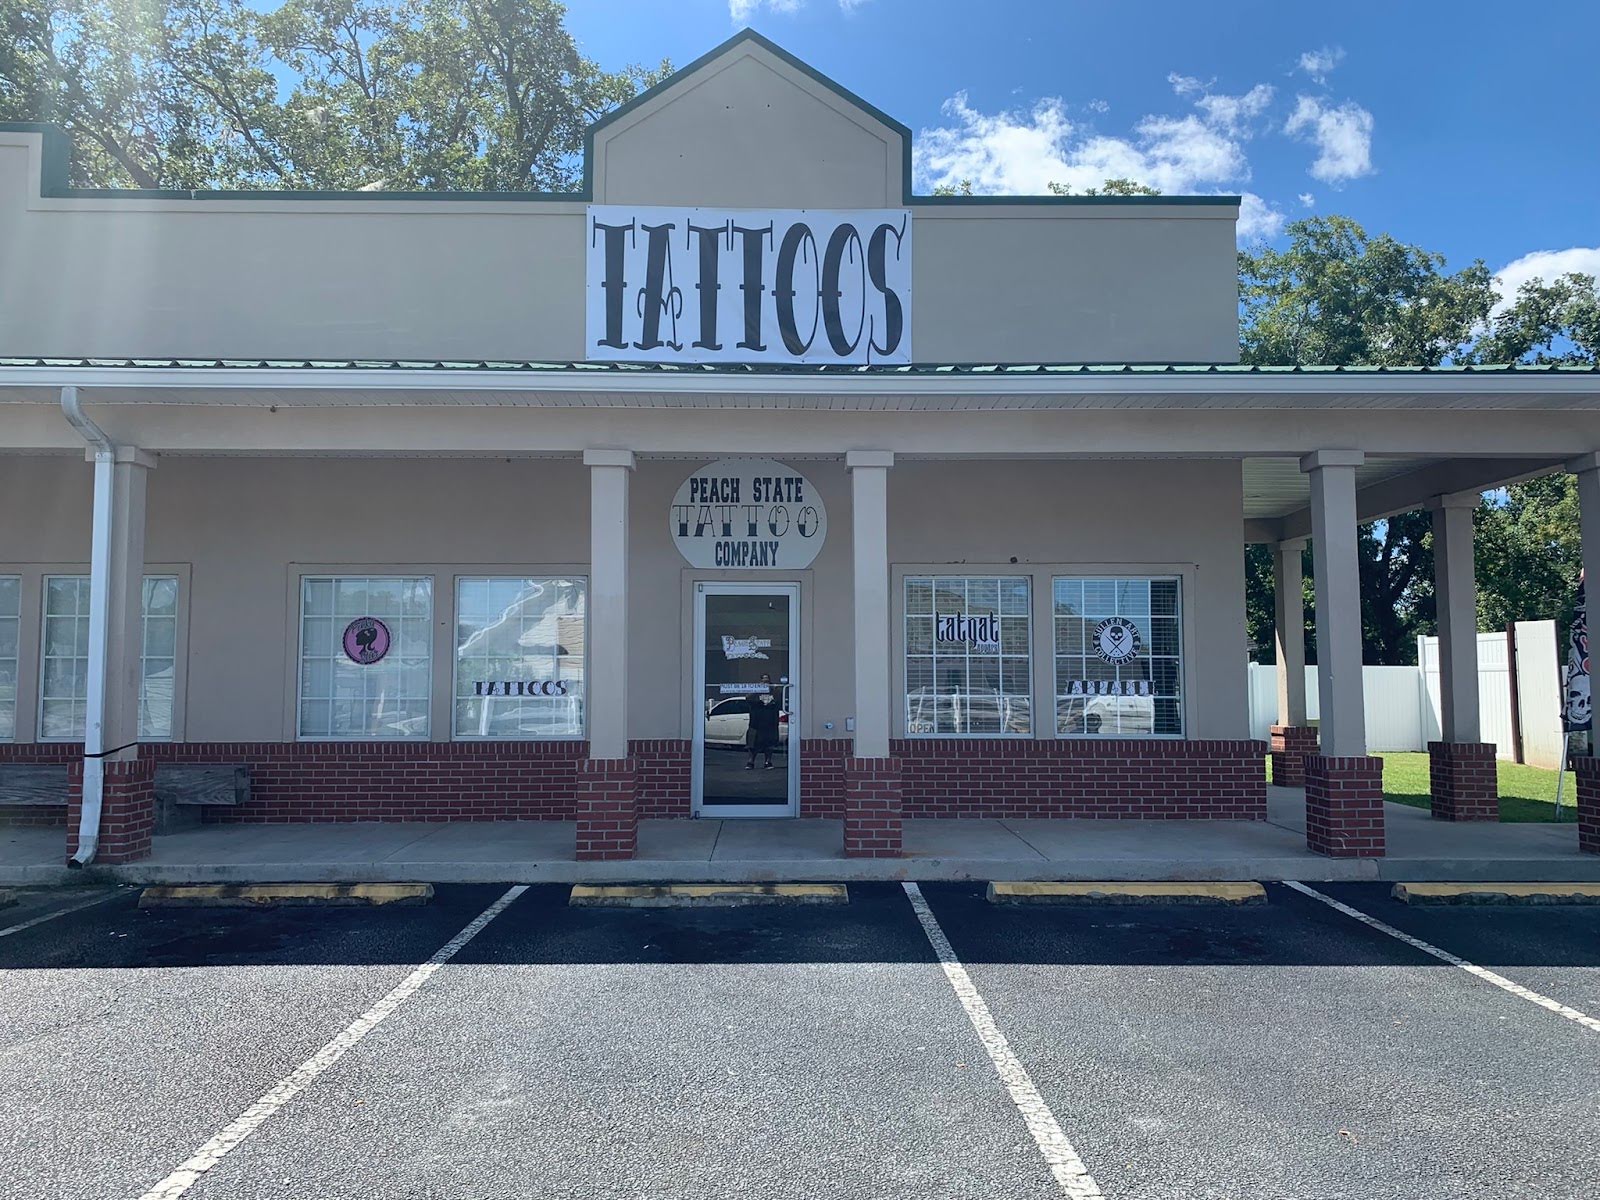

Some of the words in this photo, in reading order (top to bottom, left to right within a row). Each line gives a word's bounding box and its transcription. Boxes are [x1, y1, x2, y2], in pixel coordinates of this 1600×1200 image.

[592, 213, 907, 365] TATTOOS
[690, 477, 740, 503] PEACH
[753, 477, 803, 503] STATE
[672, 504, 819, 538] TATTOO
[715, 541, 779, 567] COMPANY
[1094, 618, 1123, 638] SULLEN
[1125, 622, 1140, 638] ART
[1094, 646, 1138, 665] COLLECTIVE
[472, 679, 568, 696] TATTOOS
[910, 723, 935, 733] OPEN
